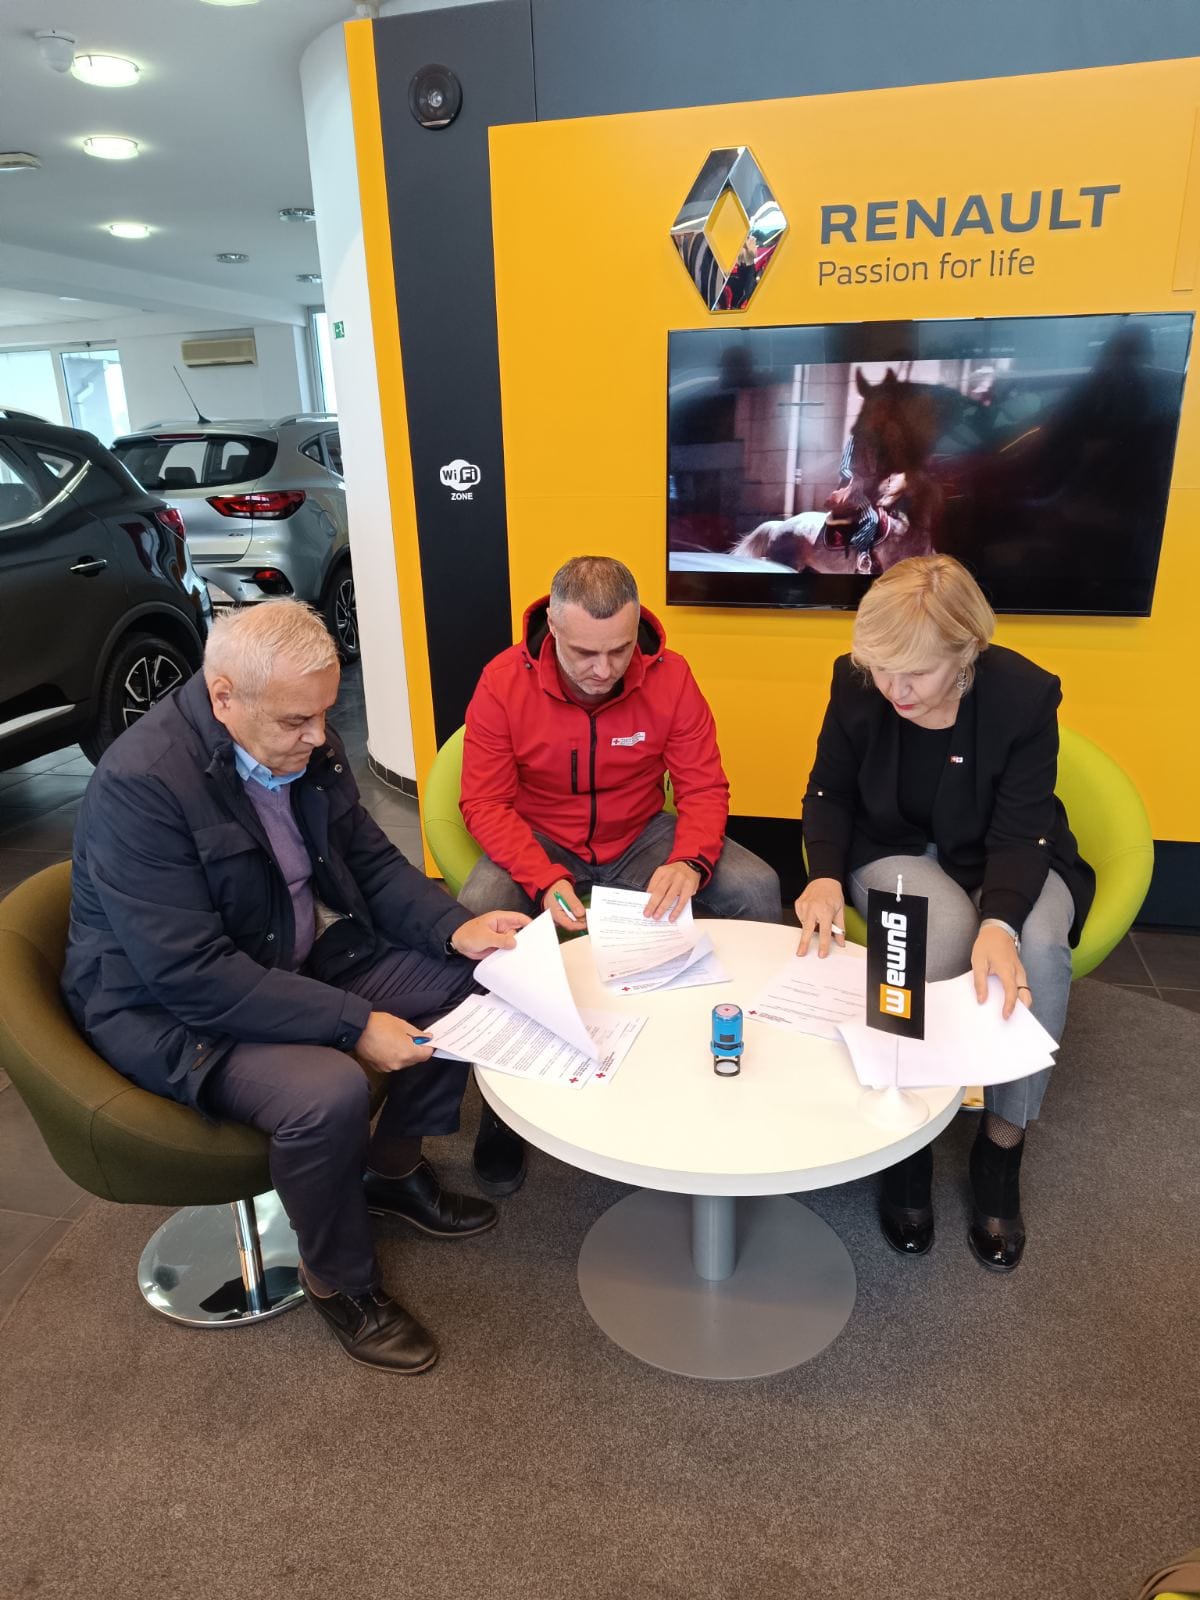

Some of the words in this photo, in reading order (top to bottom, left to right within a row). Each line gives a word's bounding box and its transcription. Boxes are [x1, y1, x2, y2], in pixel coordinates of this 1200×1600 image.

[820, 185, 1121, 245] RENAULT
[818, 256, 928, 286] Passion
[939, 251, 982, 280] for
[990, 248, 1036, 277] life
[451, 492, 473, 501] ZONE
